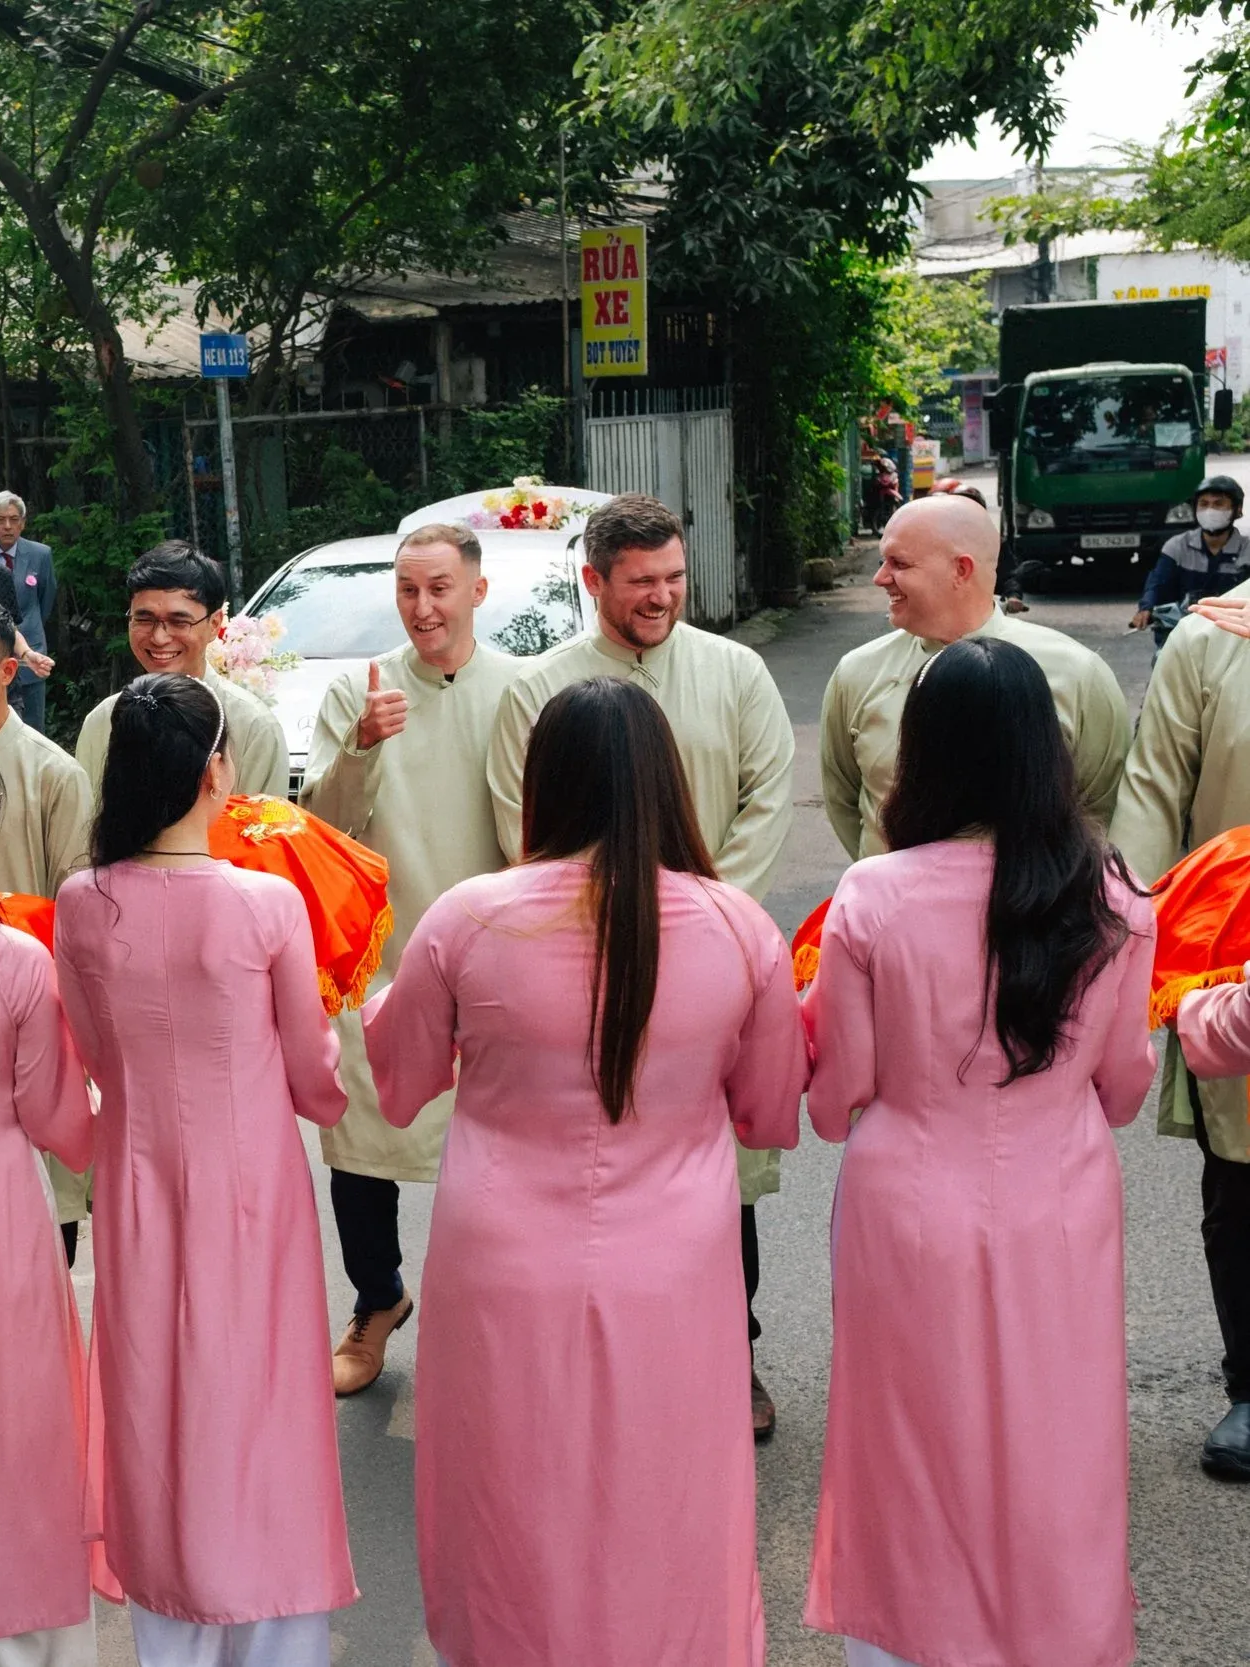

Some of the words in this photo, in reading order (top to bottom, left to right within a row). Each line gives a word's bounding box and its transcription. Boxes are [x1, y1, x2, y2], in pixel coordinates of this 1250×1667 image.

[583, 233, 639, 282] RỬA
[594, 290, 629, 326] XE
[229, 347, 245, 366] 113
